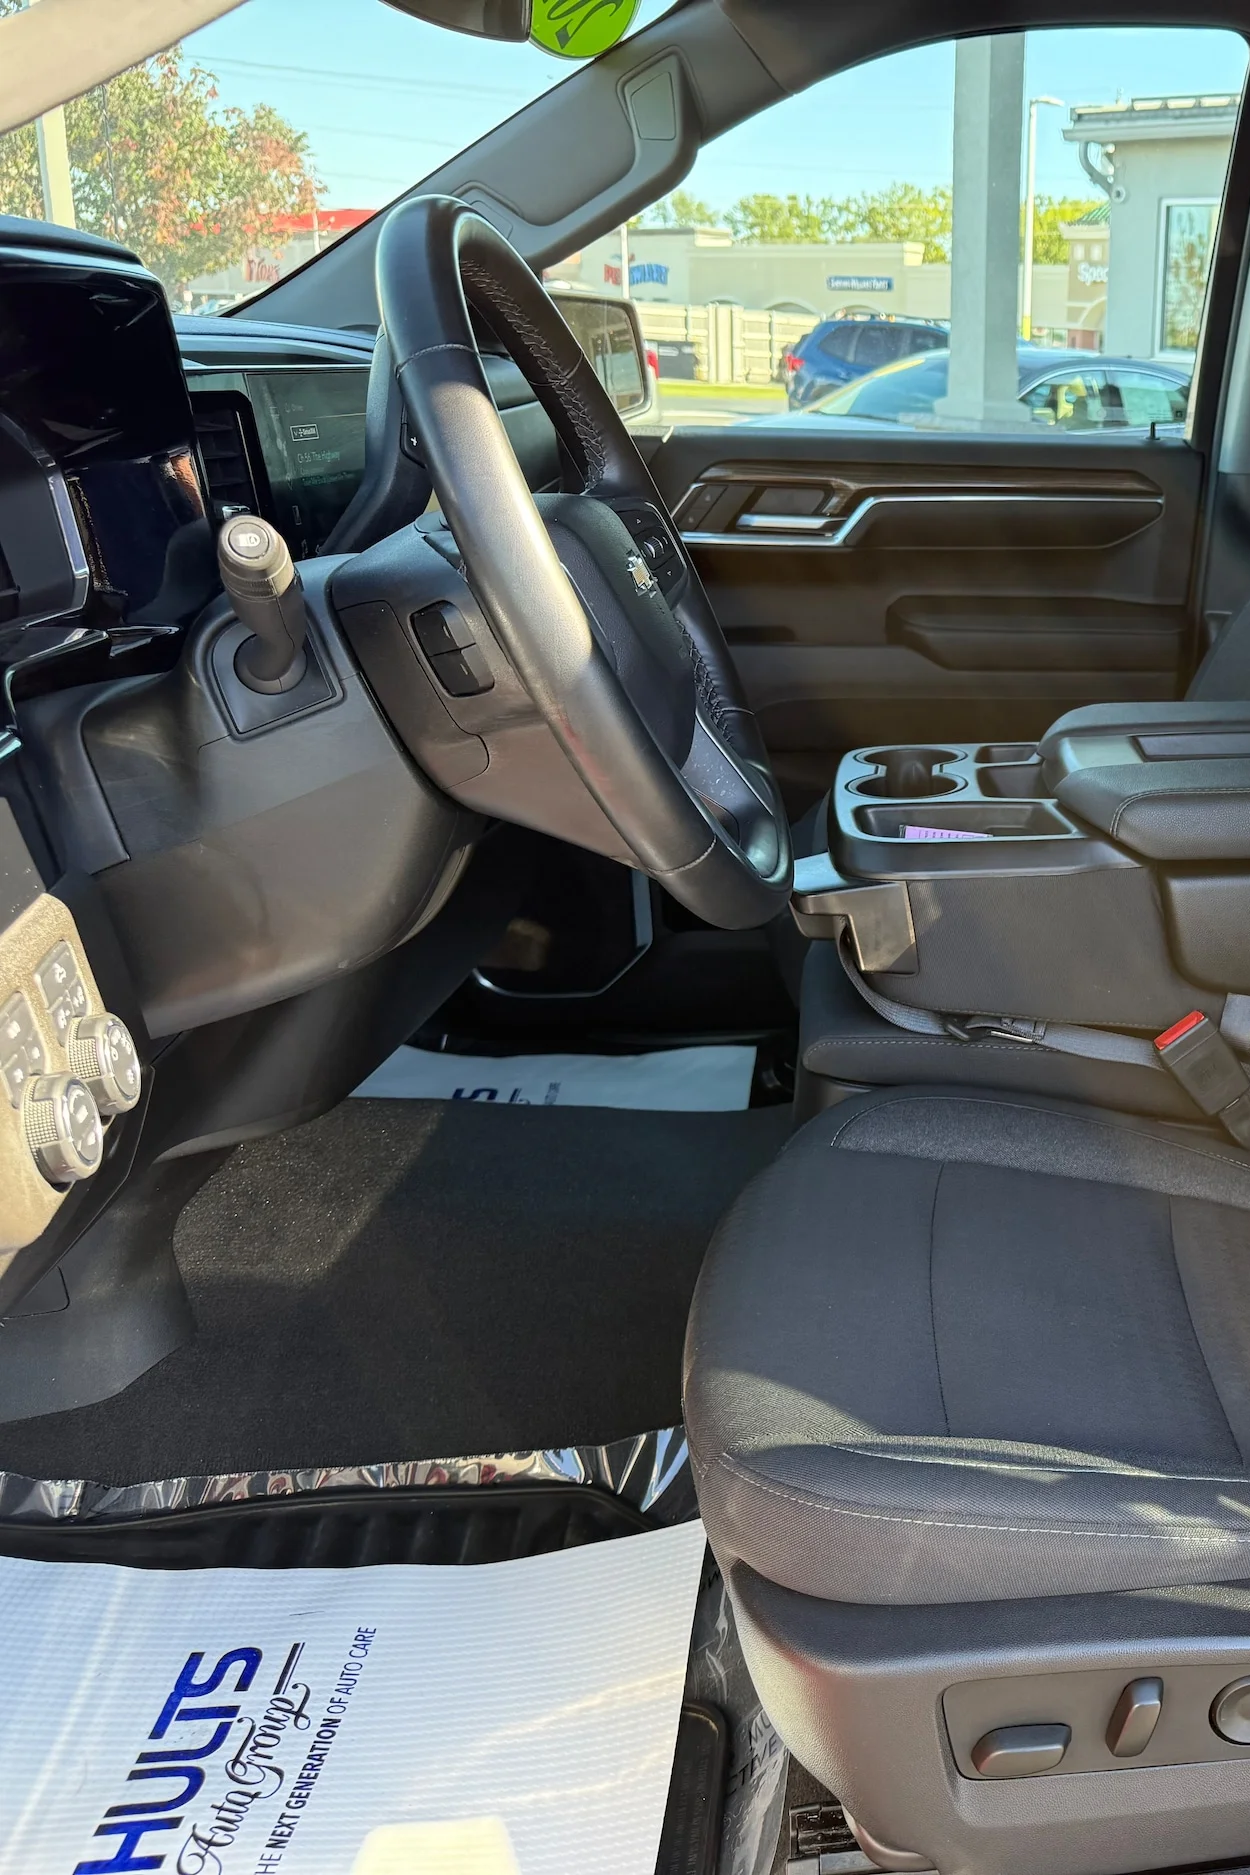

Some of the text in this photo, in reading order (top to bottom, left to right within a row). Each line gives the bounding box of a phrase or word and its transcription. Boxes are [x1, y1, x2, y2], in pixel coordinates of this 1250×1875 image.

[224, 1682, 311, 1800] Group
[253, 1626, 377, 1875] HE NEXT GENERATION OF AUTO CARE
